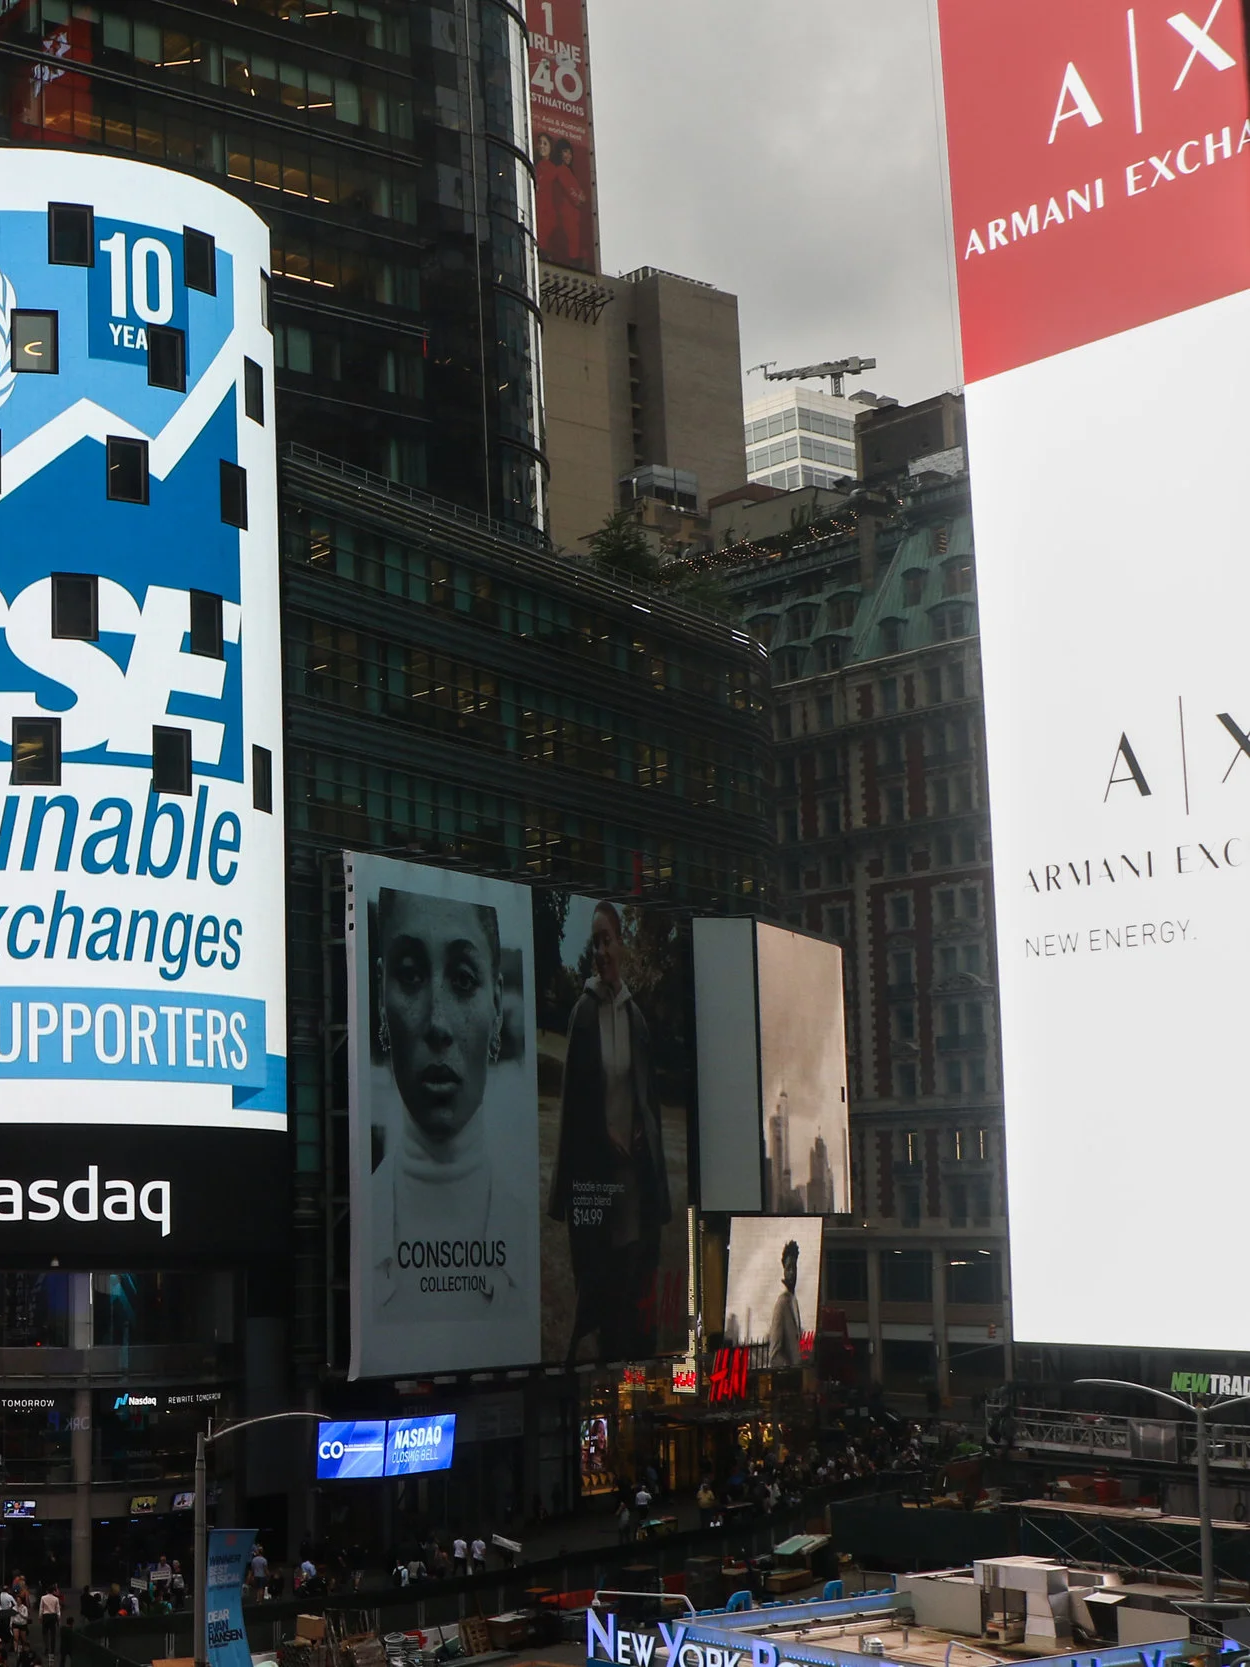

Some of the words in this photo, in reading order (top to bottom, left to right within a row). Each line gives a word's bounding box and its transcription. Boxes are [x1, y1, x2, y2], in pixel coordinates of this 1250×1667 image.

[541, 2, 553, 35] 1
[531, 58, 583, 102] 40
[965, 178, 1104, 260] ARMANI
[100, 231, 174, 325] 10
[108, 322, 148, 350] YEA
[1023, 851, 1153, 893] ARMANI
[1025, 932, 1079, 958] NEW
[1089, 920, 1197, 951] ENERGY.
[573, 1208, 603, 1226] $14.99
[398, 1240, 507, 1270] CONSCIOUS
[420, 1275, 487, 1293] COLLECTION
[1, 1400, 55, 1408] TOMORROW
[128, 1395, 157, 1406] Nasdaq
[168, 1395, 194, 1404] REWRITE
[394, 1425, 442, 1450] NASDAQ
[421, 1447, 439, 1461] BELL
[208, 1608, 230, 1622] DEAR
[208, 1620, 229, 1633] EVAN
[208, 1628, 243, 1645] HANSEN
[586, 1608, 655, 1665] NEW
